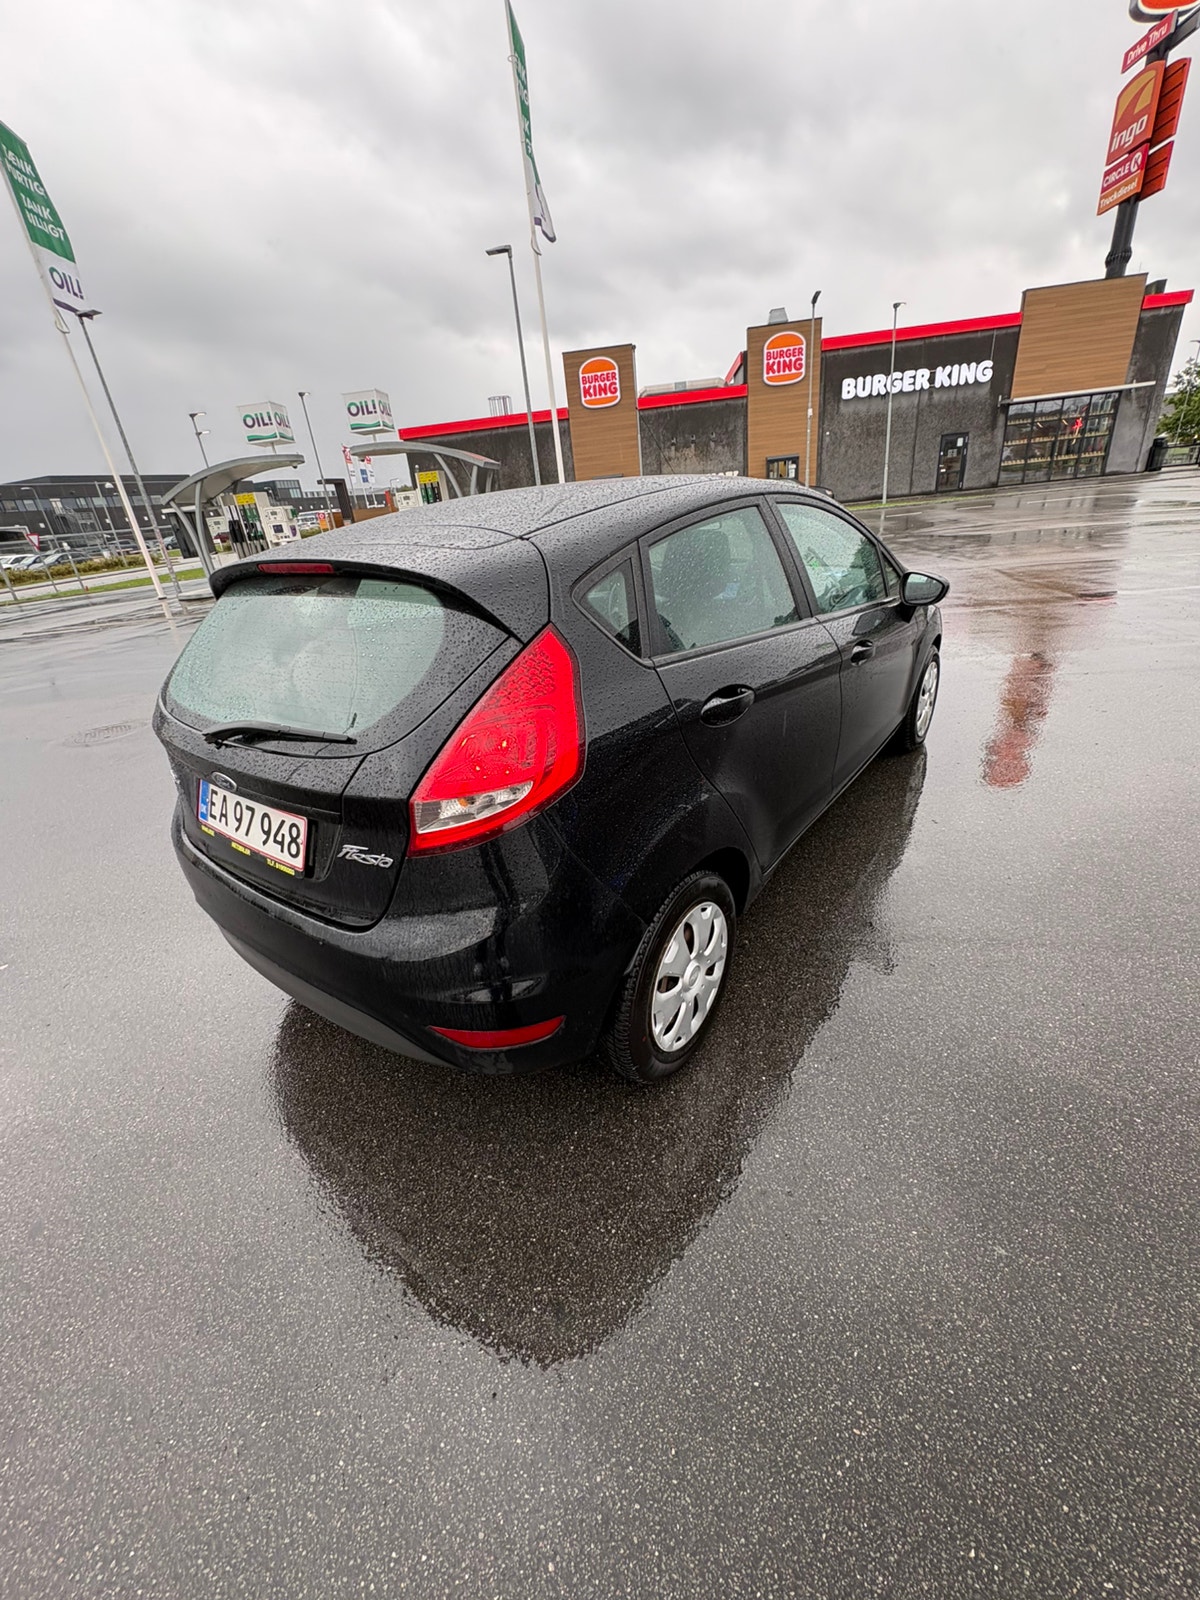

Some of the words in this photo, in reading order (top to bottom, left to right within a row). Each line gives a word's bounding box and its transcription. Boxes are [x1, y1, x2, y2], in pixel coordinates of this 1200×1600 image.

[1127, 41, 1147, 65] Drive
[1148, 23, 1168, 46] Thru
[1110, 114, 1148, 153] ingo
[1103, 162, 1130, 187] CIRCLE
[20, 193, 53, 222] TANK
[49, 266, 84, 300] OIL!
[765, 346, 804, 360] BURGER
[765, 358, 804, 375] KING
[581, 371, 617, 386] BURGER
[841, 367, 930, 400] BURGER
[934, 360, 993, 388] KING
[582, 385, 618, 398] KING
[347, 399, 377, 417] OIL!
[379, 400, 392, 417] OIL!
[243, 411, 273, 429] OIL!
[274, 411, 290, 429] OIL!
[260, 812, 301, 859] 948
[337, 844, 394, 868] Fiesta
